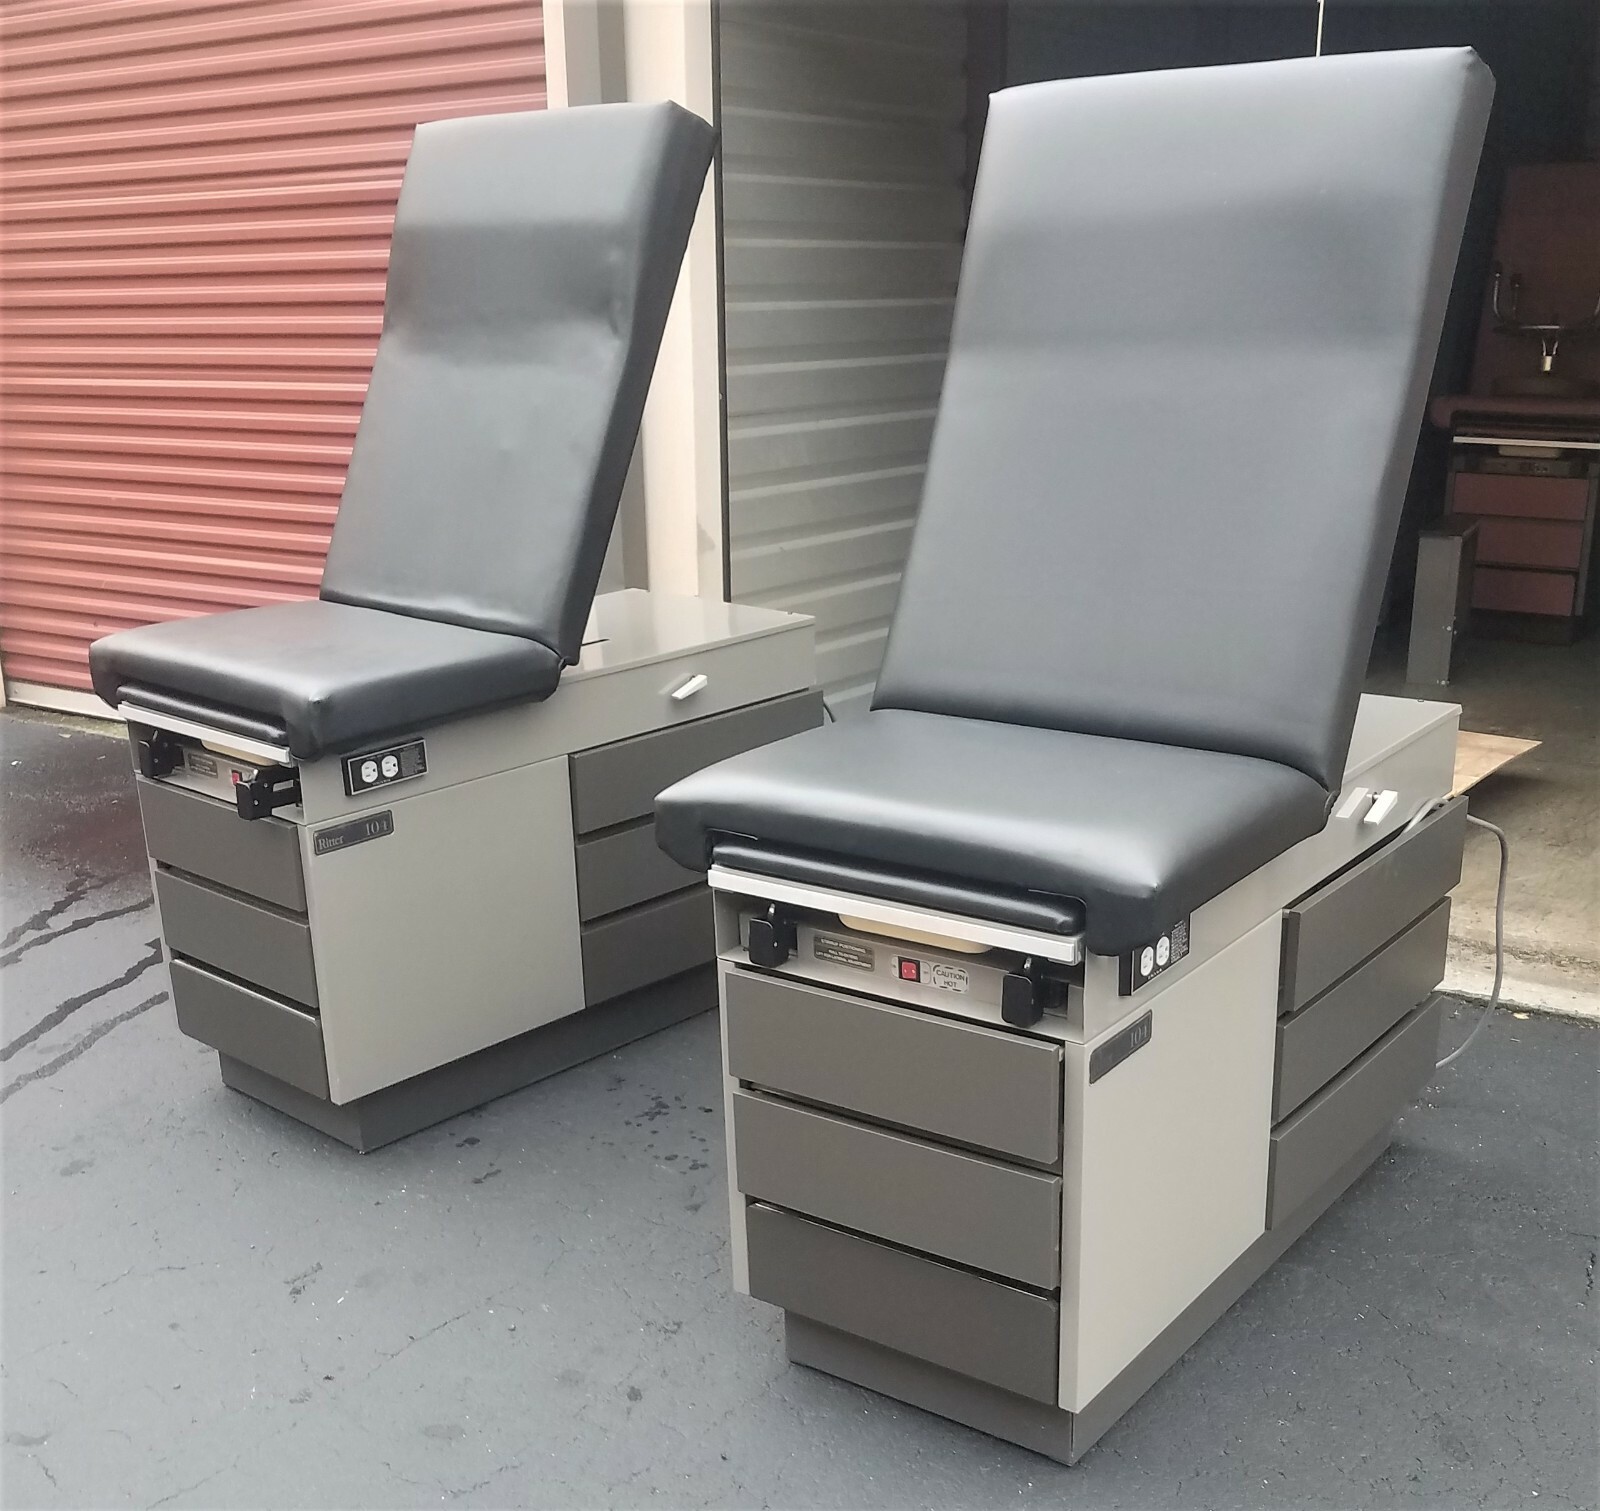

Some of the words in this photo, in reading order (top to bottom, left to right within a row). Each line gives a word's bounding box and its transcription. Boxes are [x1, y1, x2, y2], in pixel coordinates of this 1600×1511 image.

[318, 835, 344, 850] Ritter
[936, 969, 965, 981] CAUTION
[943, 980, 957, 988] HOT
